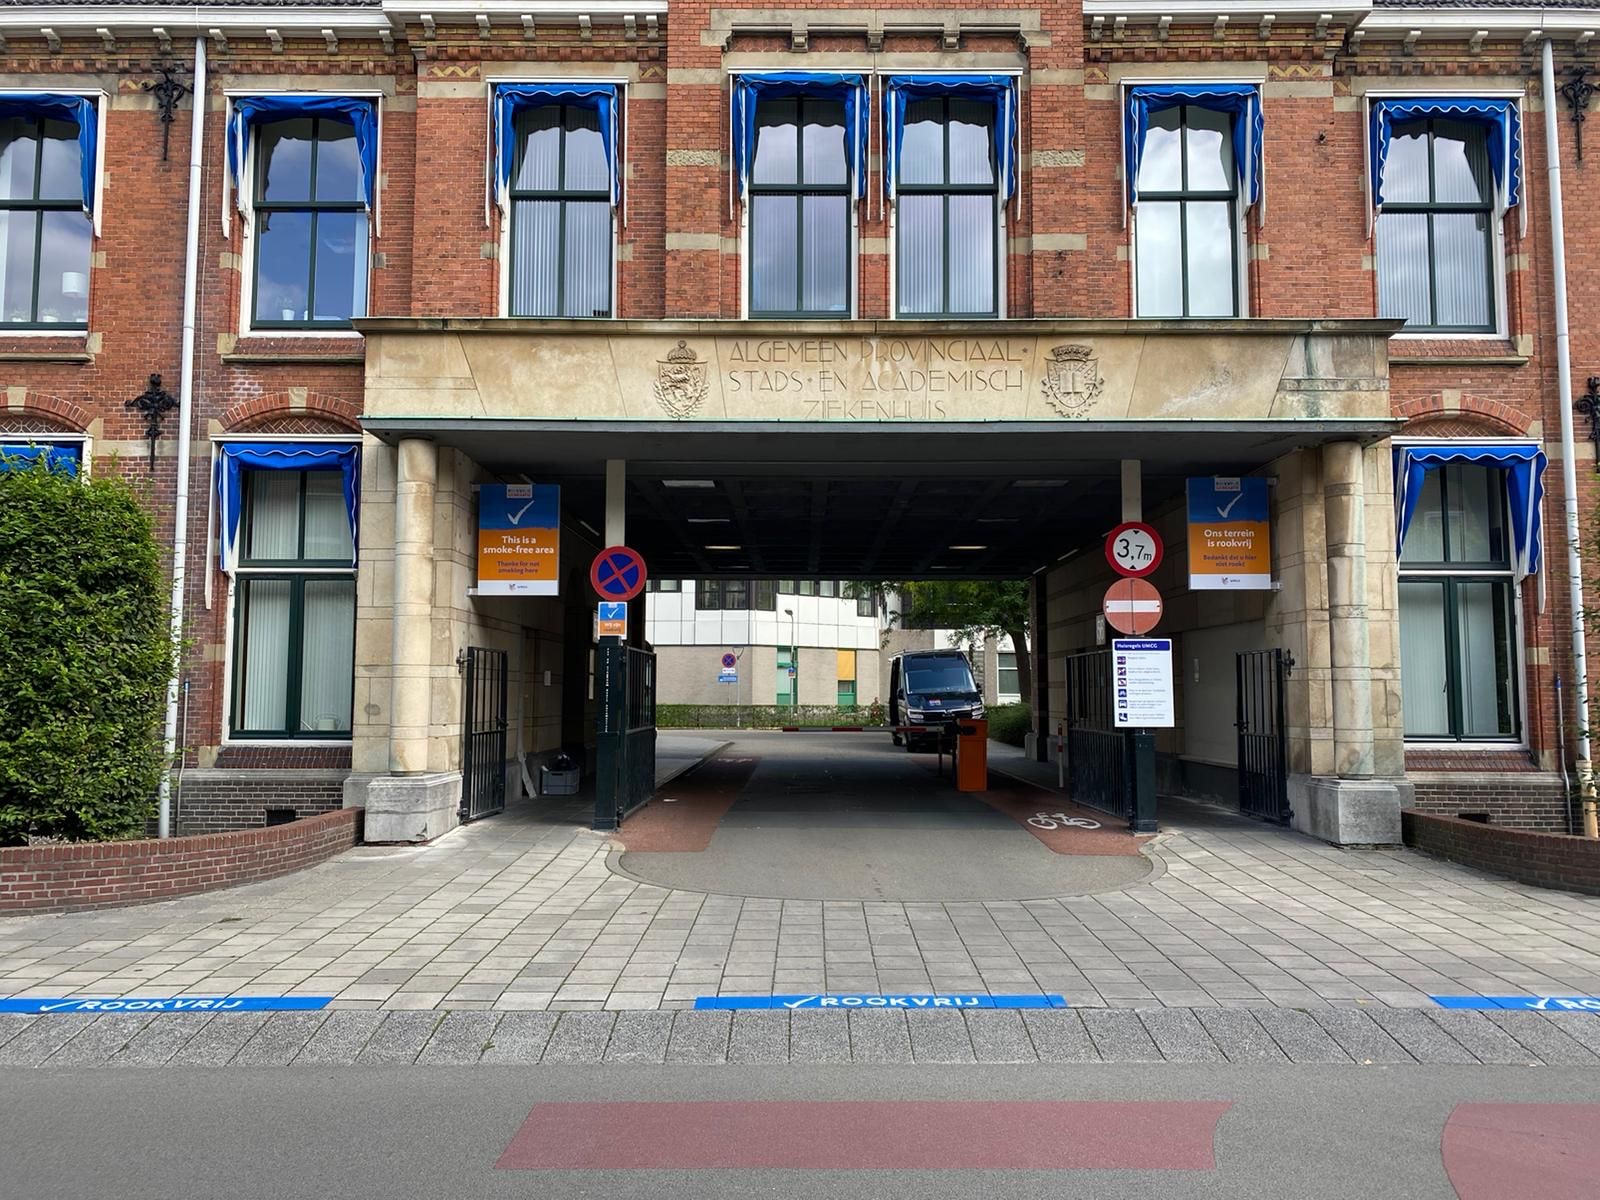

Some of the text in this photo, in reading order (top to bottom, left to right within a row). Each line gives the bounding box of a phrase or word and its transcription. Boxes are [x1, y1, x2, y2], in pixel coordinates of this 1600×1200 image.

[729, 340, 1023, 363] ALGEMEEN PROVINCIAAL
[728, 369, 1024, 393] STADS EN ACADEMISCH
[803, 399, 947, 419] ZIEKENHUIS
[1203, 529, 1255, 538] Ons terrein
[501, 535, 520, 544] This
[522, 535, 529, 544] is
[1207, 539, 1252, 549] is rookvrij
[483, 545, 534, 554] smoke-free
[76, 1000, 244, 1010] ROOKVRIJ
[820, 996, 980, 1007] ROOKVRIJ
